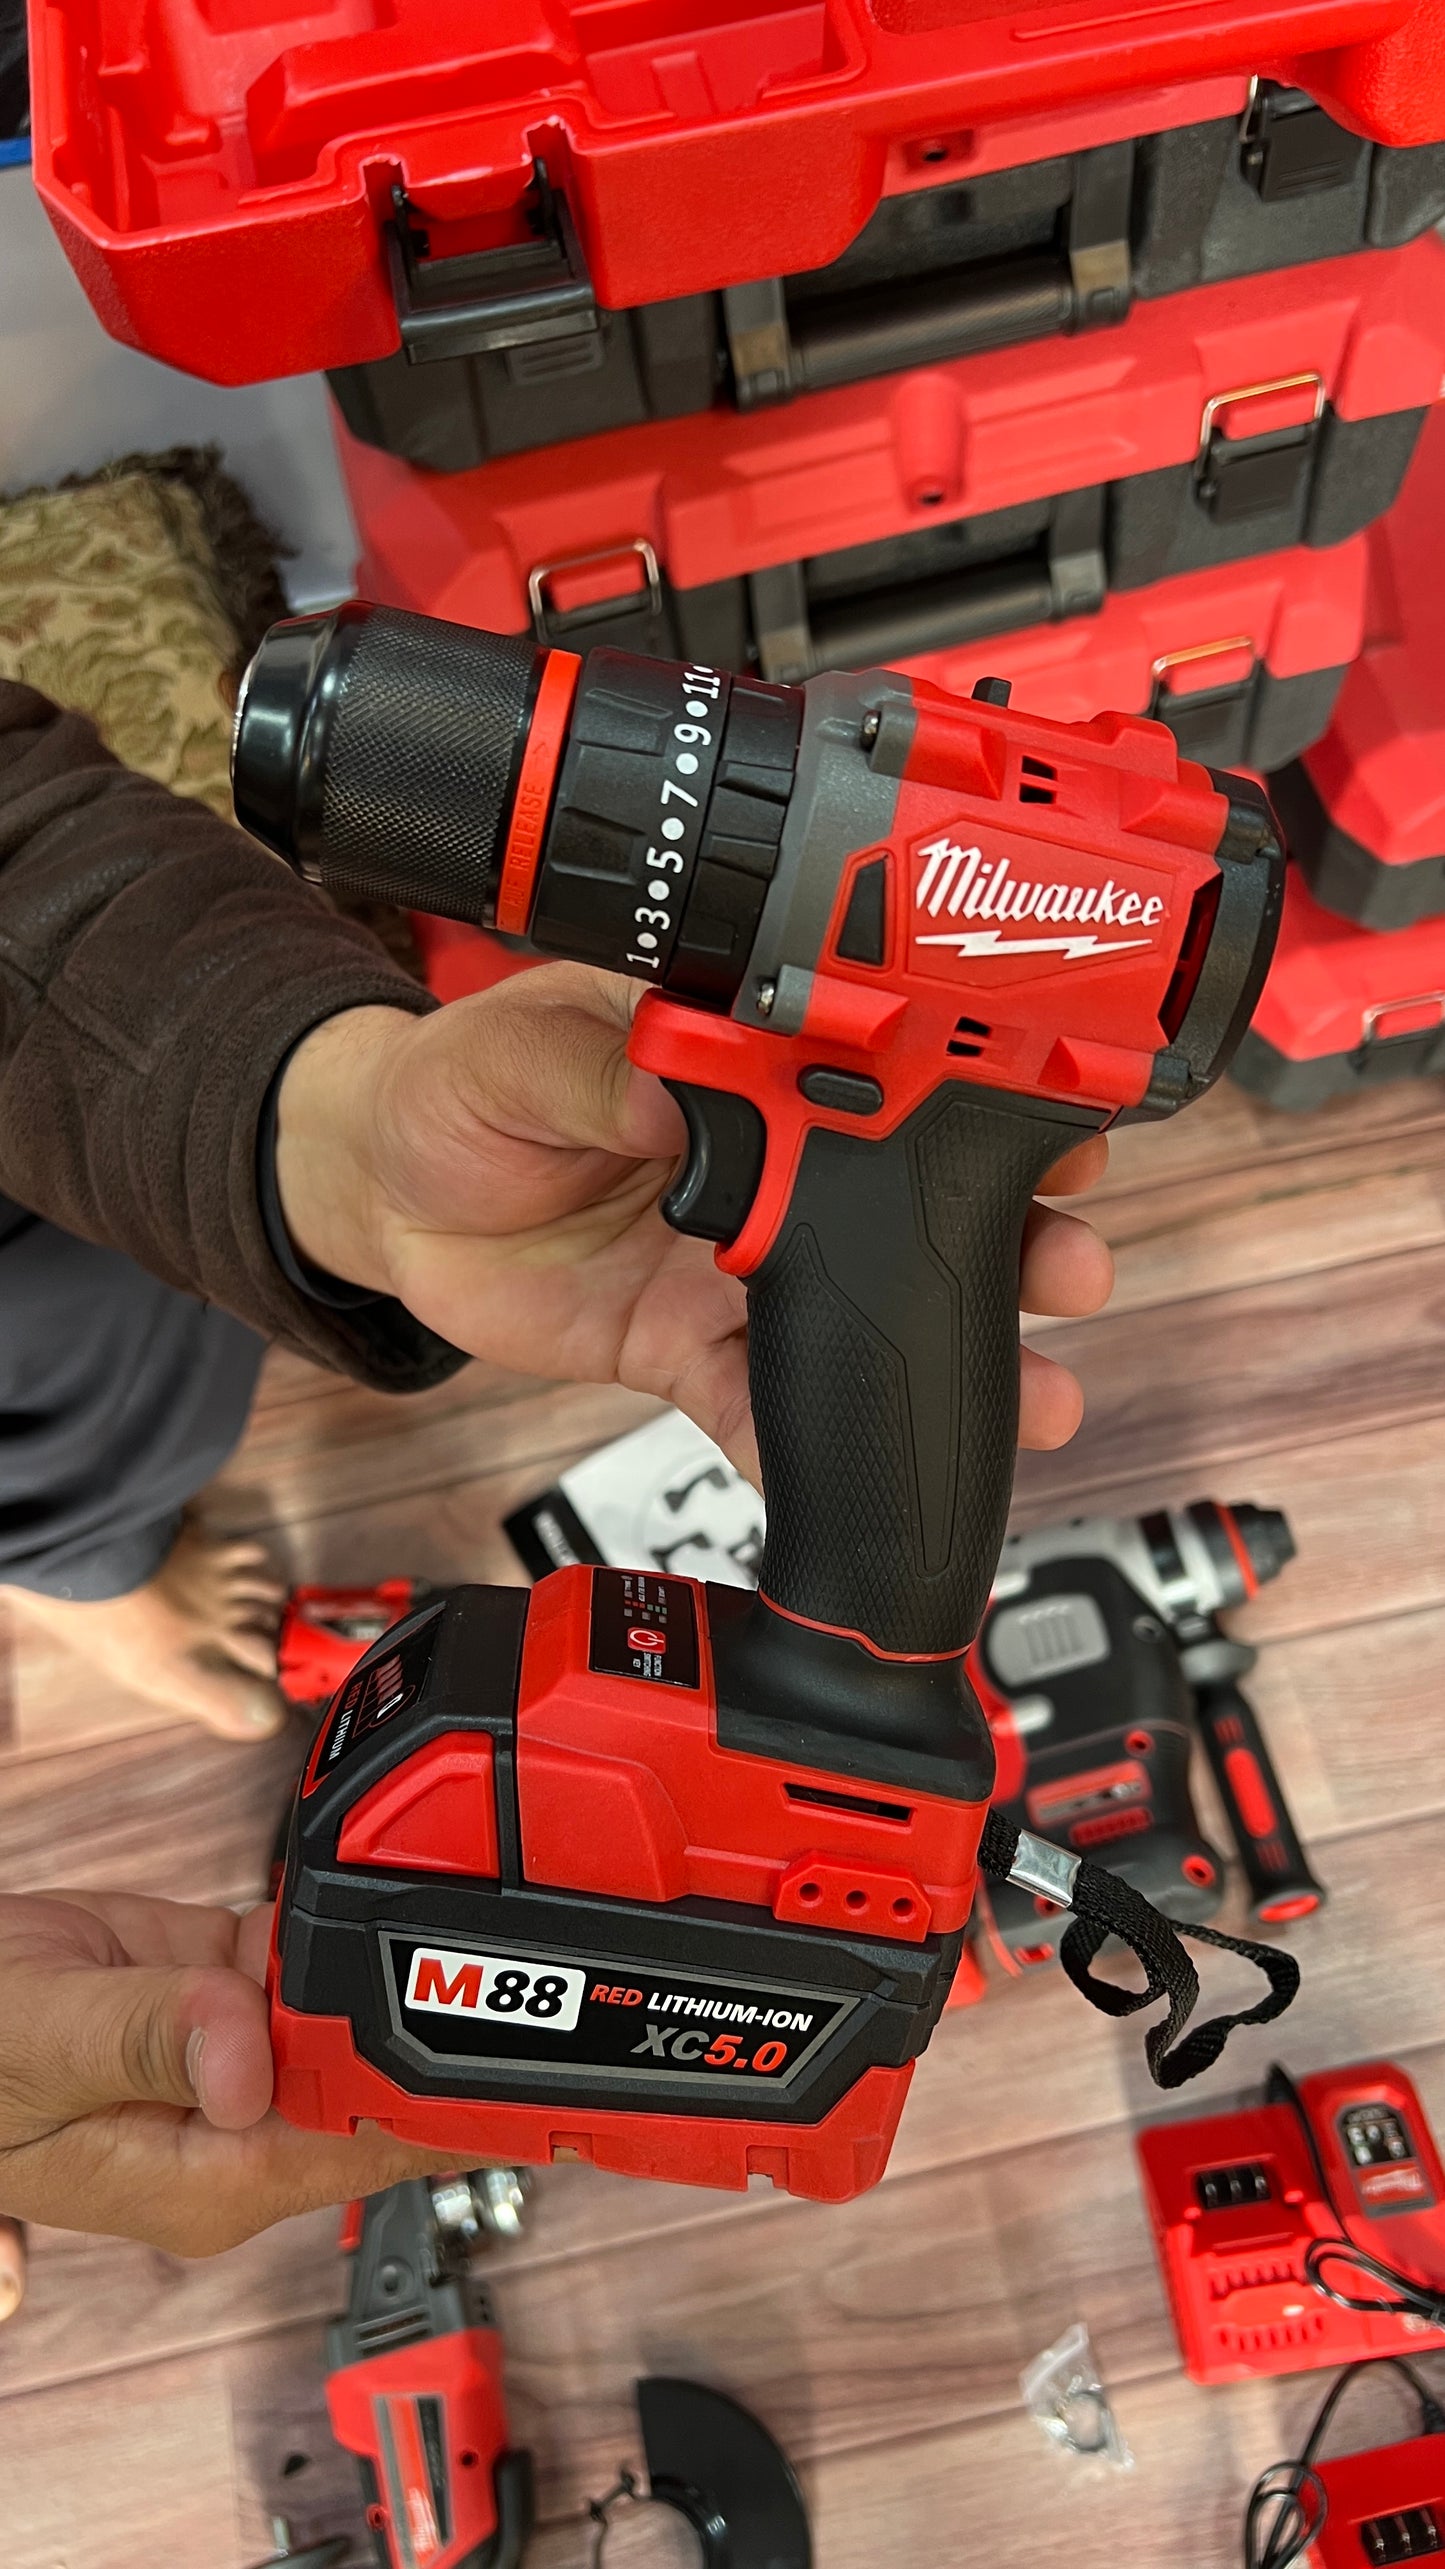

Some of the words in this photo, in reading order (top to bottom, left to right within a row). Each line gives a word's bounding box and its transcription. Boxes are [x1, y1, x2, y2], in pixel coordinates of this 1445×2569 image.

[673, 722, 712, 746] 9
[660, 779, 699, 808] 7
[510, 780, 545, 871] RELEASE
[646, 846, 684, 874] 5
[916, 837, 1164, 927] Milwaukee
[634, 906, 671, 930] 3
[626, 951, 661, 969] 1
[344, 1680, 364, 1710] RED
[328, 1709, 354, 1761] LITHIUM
[412, 1957, 569, 2018] M88
[589, 1983, 643, 2007] RED
[647, 1991, 813, 2032] LITHIUM-ION
[630, 2023, 788, 2072] XC5.0
